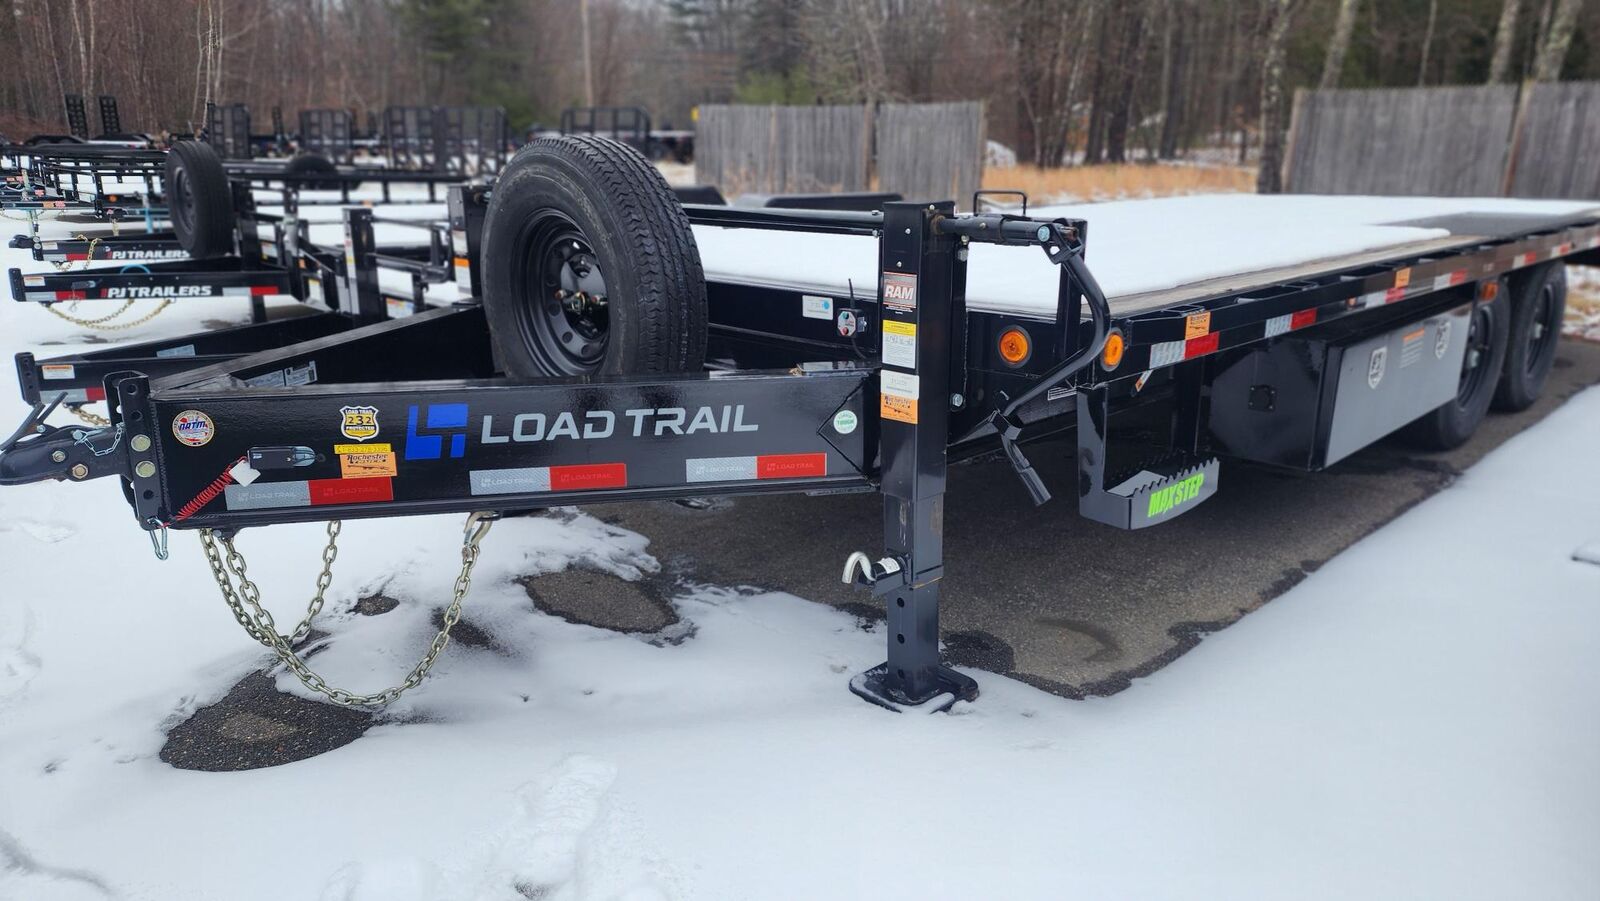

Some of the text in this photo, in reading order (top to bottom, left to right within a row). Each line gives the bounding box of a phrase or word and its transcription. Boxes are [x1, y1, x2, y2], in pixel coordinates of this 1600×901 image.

[112, 250, 190, 259] PJ TRAILERS
[107, 285, 212, 298] PJ TRAILERS
[885, 285, 914, 300] RAM
[348, 415, 372, 425] 232
[481, 404, 759, 444] LOAD TRAIL
[347, 453, 388, 462] Rochester
